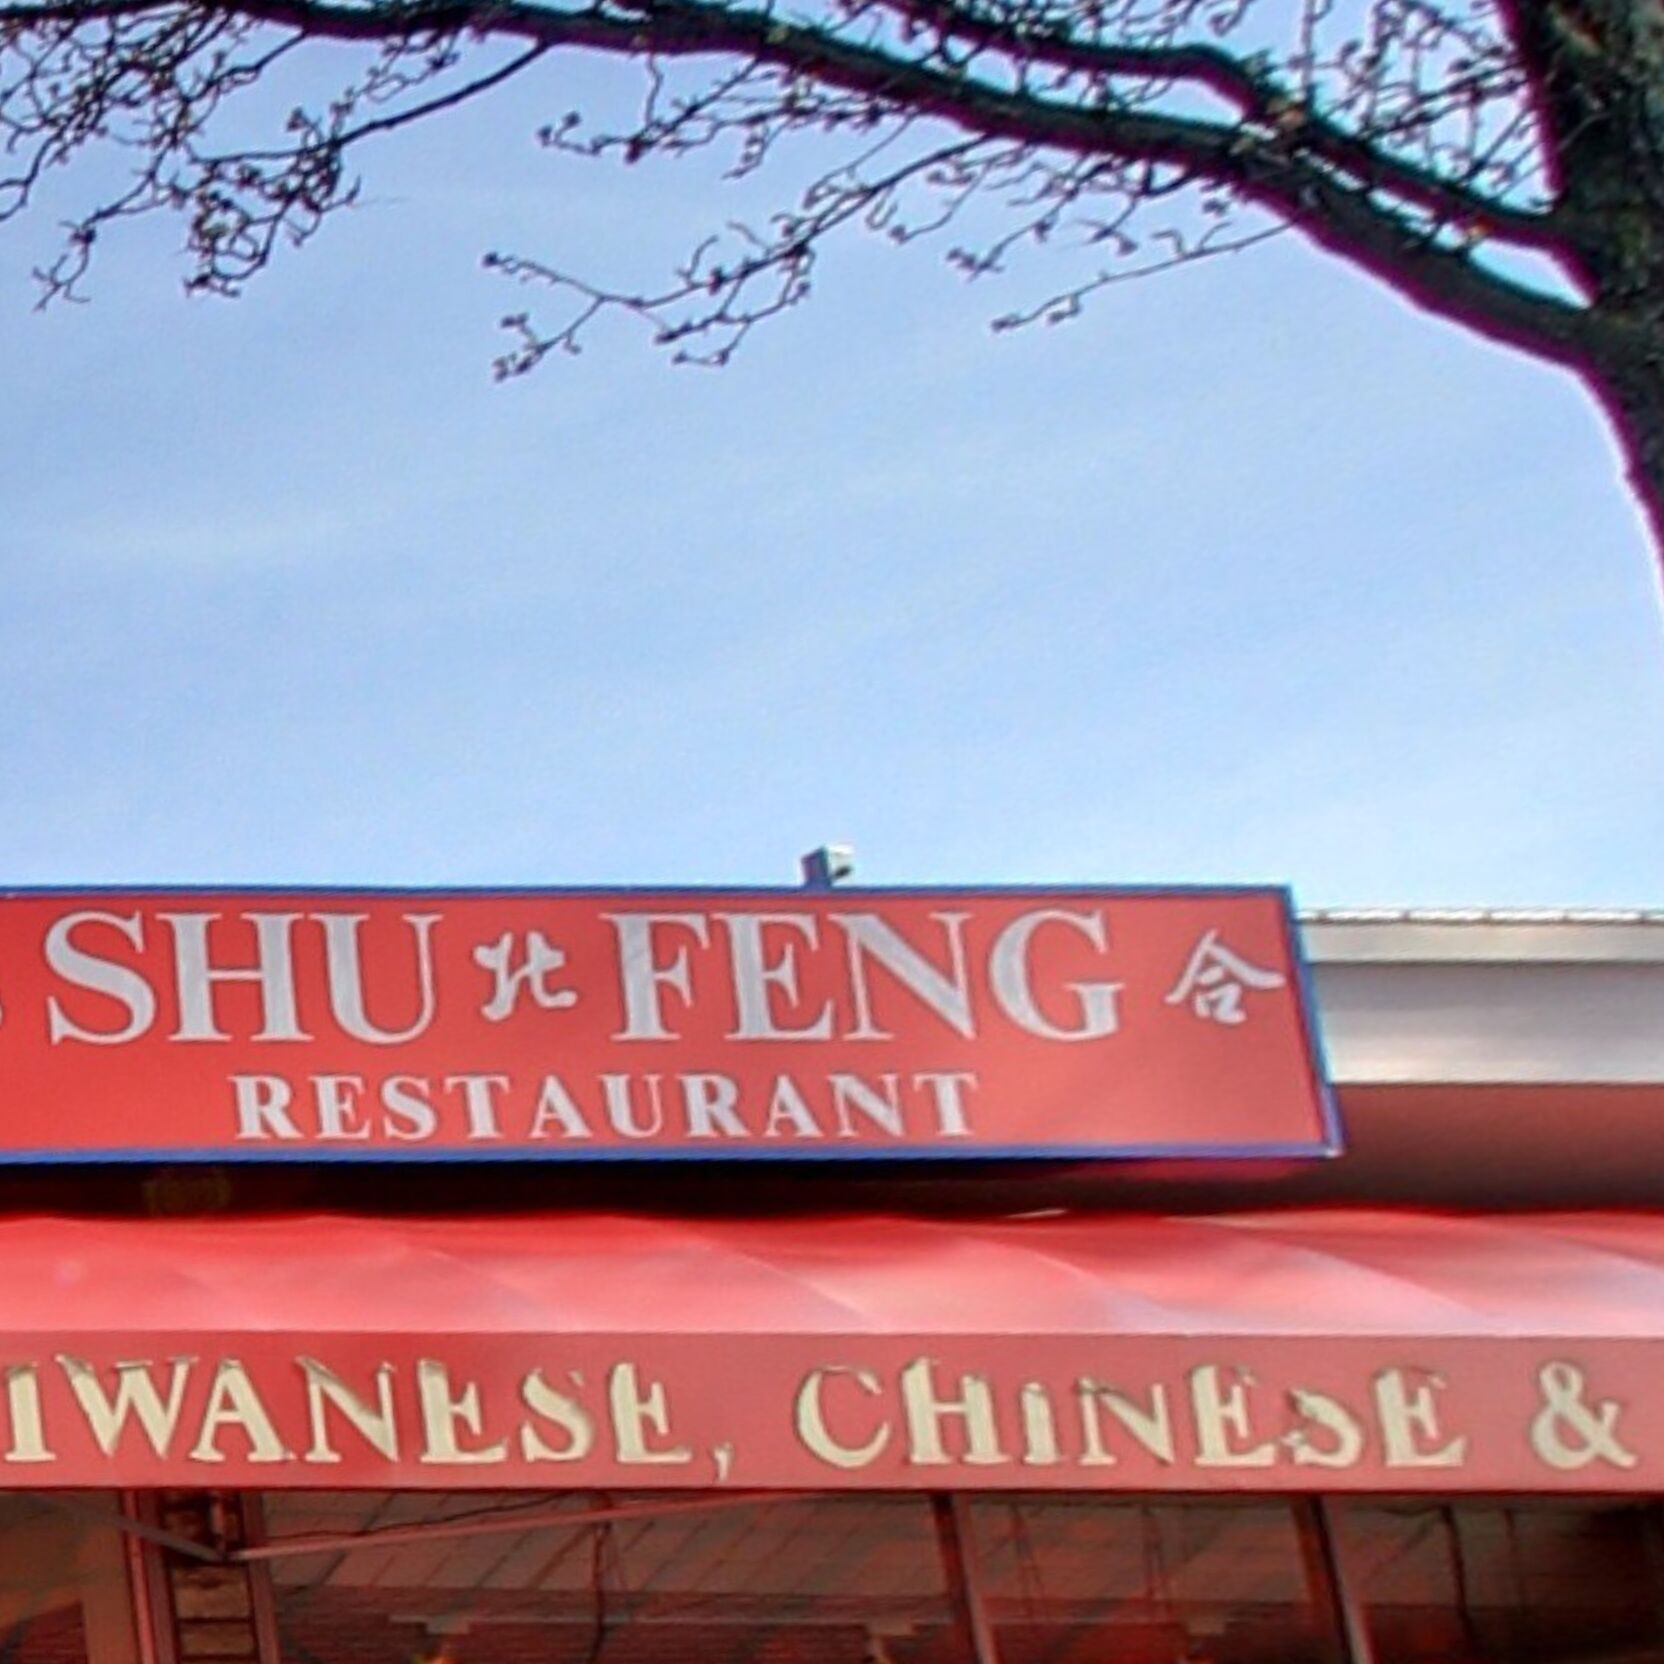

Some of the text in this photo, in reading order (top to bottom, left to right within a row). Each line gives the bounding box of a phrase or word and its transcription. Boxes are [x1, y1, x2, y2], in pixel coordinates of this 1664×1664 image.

[43, 910, 437, 1045] SHU
[599, 908, 1123, 1042] FENG
[230, 1072, 978, 1139] RESTAURANT
[793, 1357, 1468, 1470] CHINESE
[1527, 1359, 1638, 1470] &
